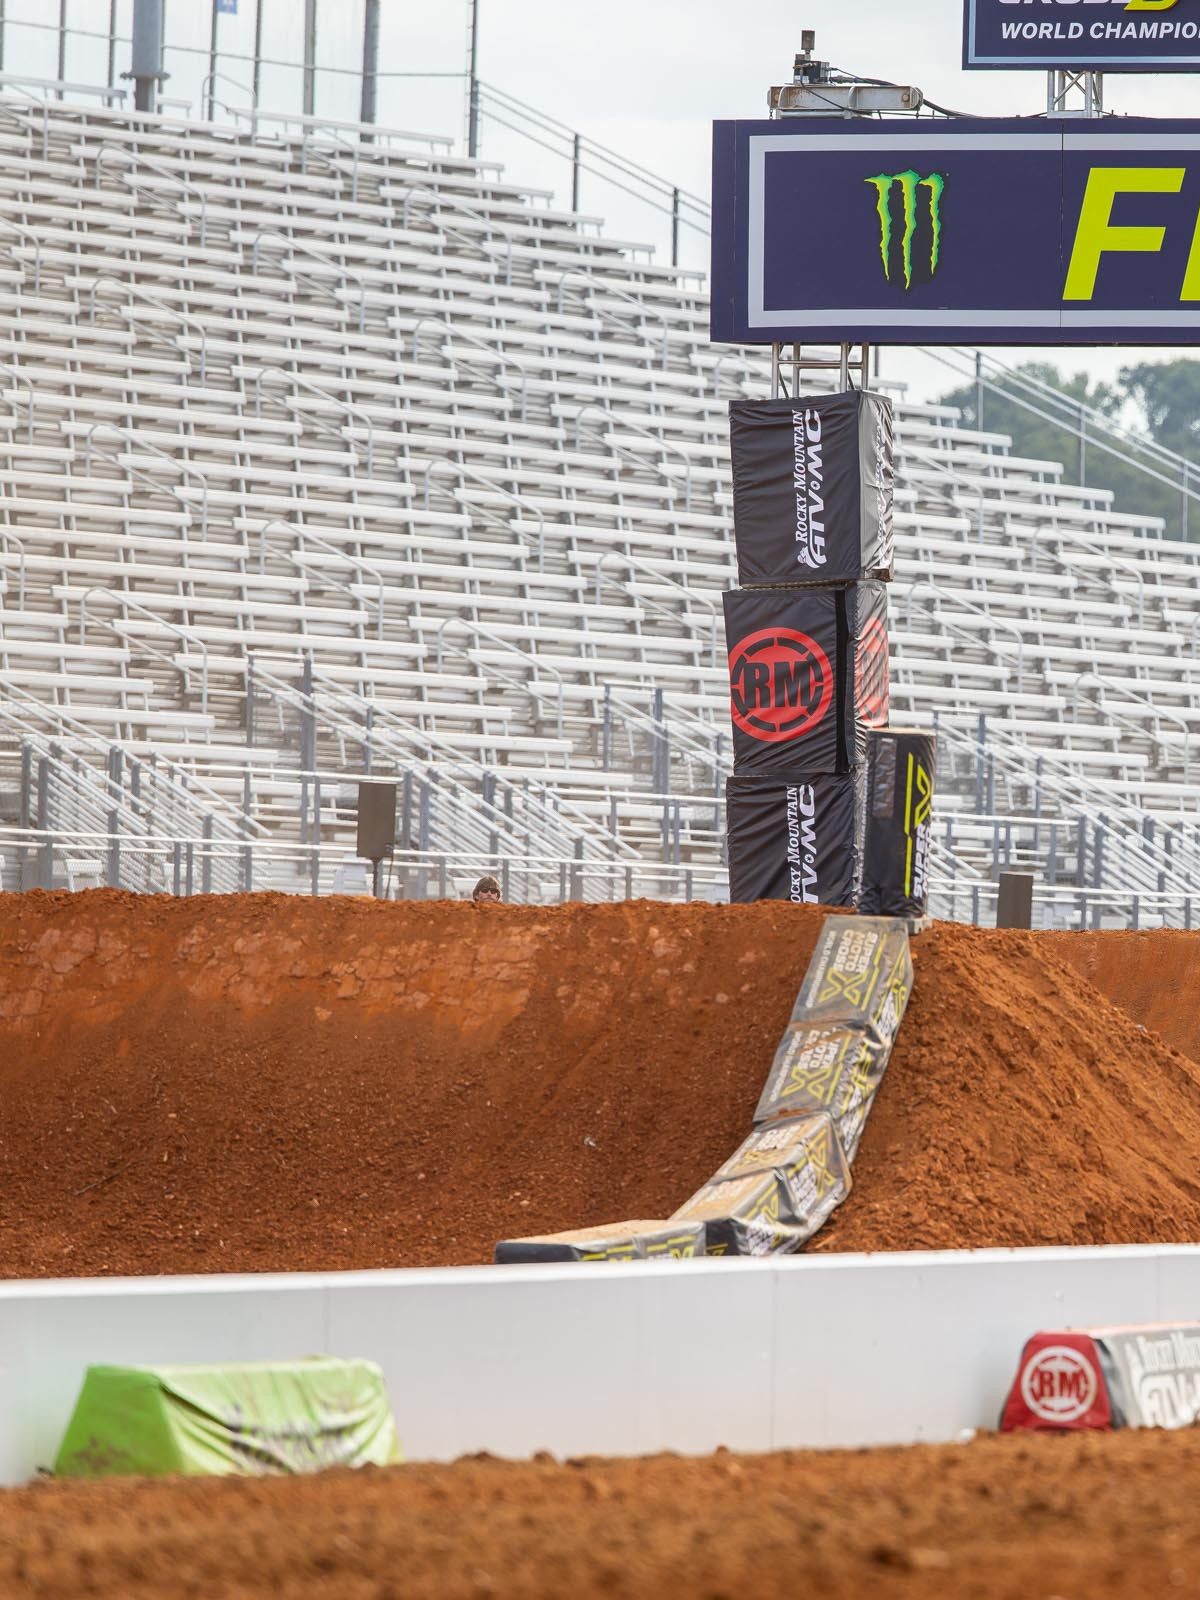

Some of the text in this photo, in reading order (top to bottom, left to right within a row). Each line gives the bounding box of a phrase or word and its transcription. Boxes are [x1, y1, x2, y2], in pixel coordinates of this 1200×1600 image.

[1001, 22, 1084, 39] WORLD
[792, 409, 808, 544] ROCKY MOUNTAIN
[743, 662, 811, 708] RM
[787, 785, 801, 903] OCKY MOUNTAIN
[913, 823, 928, 898] SUPER
[801, 862, 819, 904] TV
[833, 929, 854, 972] CROSS
[845, 931, 866, 972] MOTO
[855, 931, 878, 973] SUPER
[1038, 1371, 1081, 1392] RM
